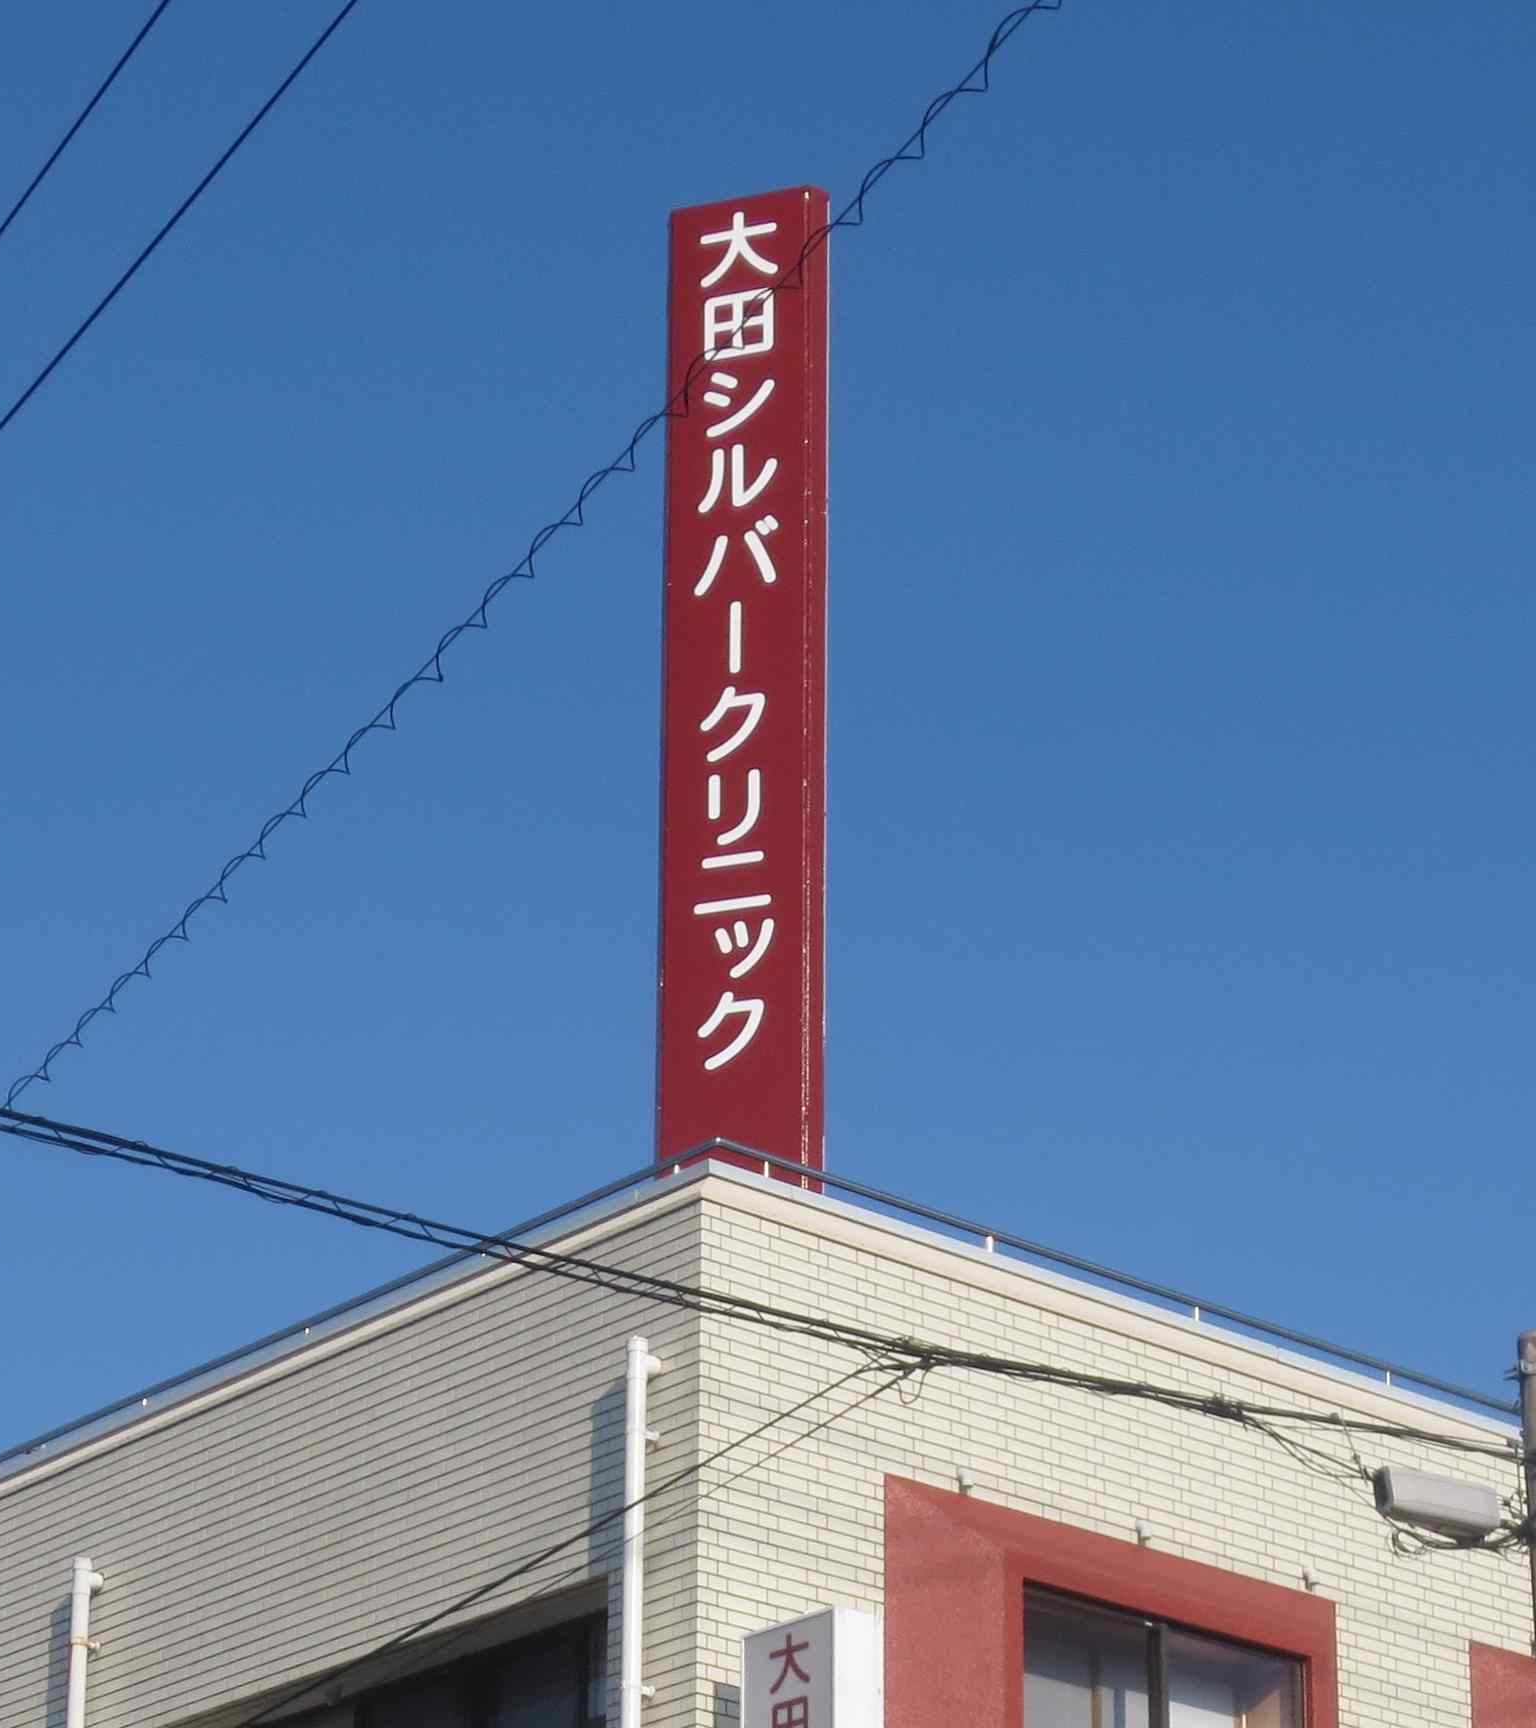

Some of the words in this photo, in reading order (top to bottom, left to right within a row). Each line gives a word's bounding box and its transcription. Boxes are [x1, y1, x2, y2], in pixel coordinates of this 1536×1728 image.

[693, 211, 779, 1071] 大田シルバークリニック
